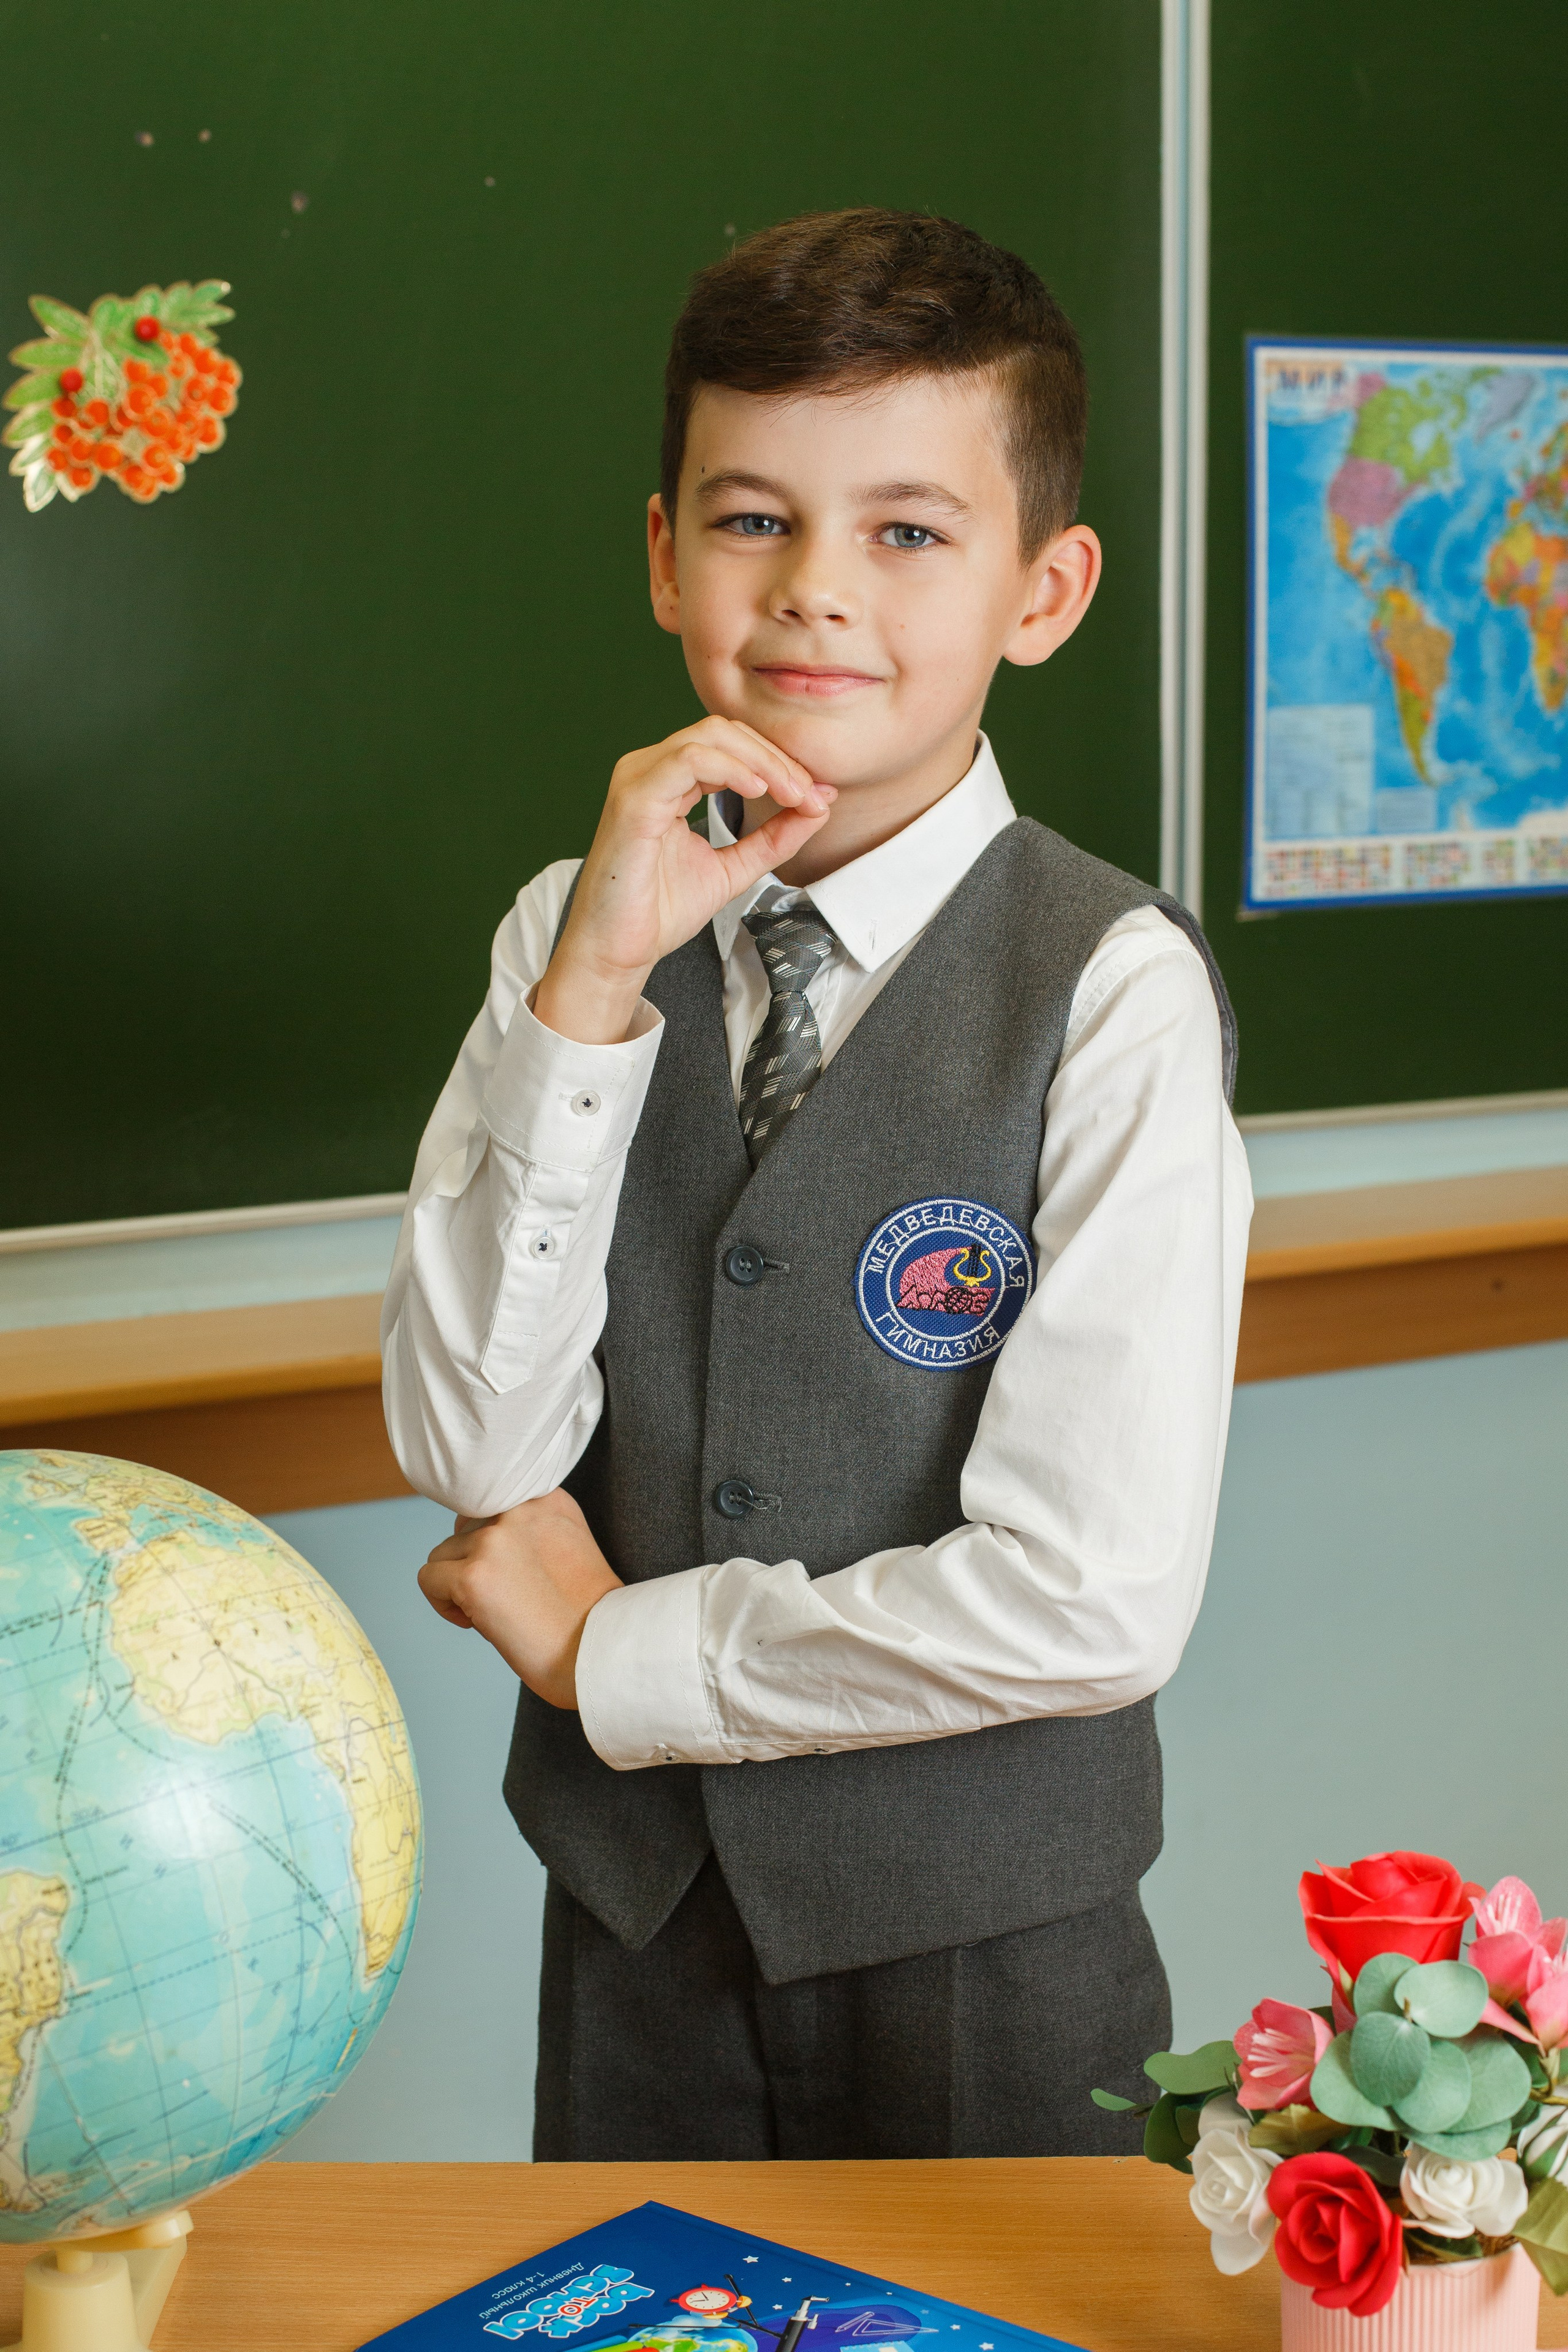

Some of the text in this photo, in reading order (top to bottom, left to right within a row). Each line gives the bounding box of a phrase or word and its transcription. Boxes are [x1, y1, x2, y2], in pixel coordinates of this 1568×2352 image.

[867, 1206, 1025, 1287] МЕДВЕДЕВСКАЯ
[876, 1310, 1000, 1358] ГИМНАЗИЯ
[479, 2262, 584, 2320] Дневник школьный
[492, 2272, 545, 2299] 1-4 класс
